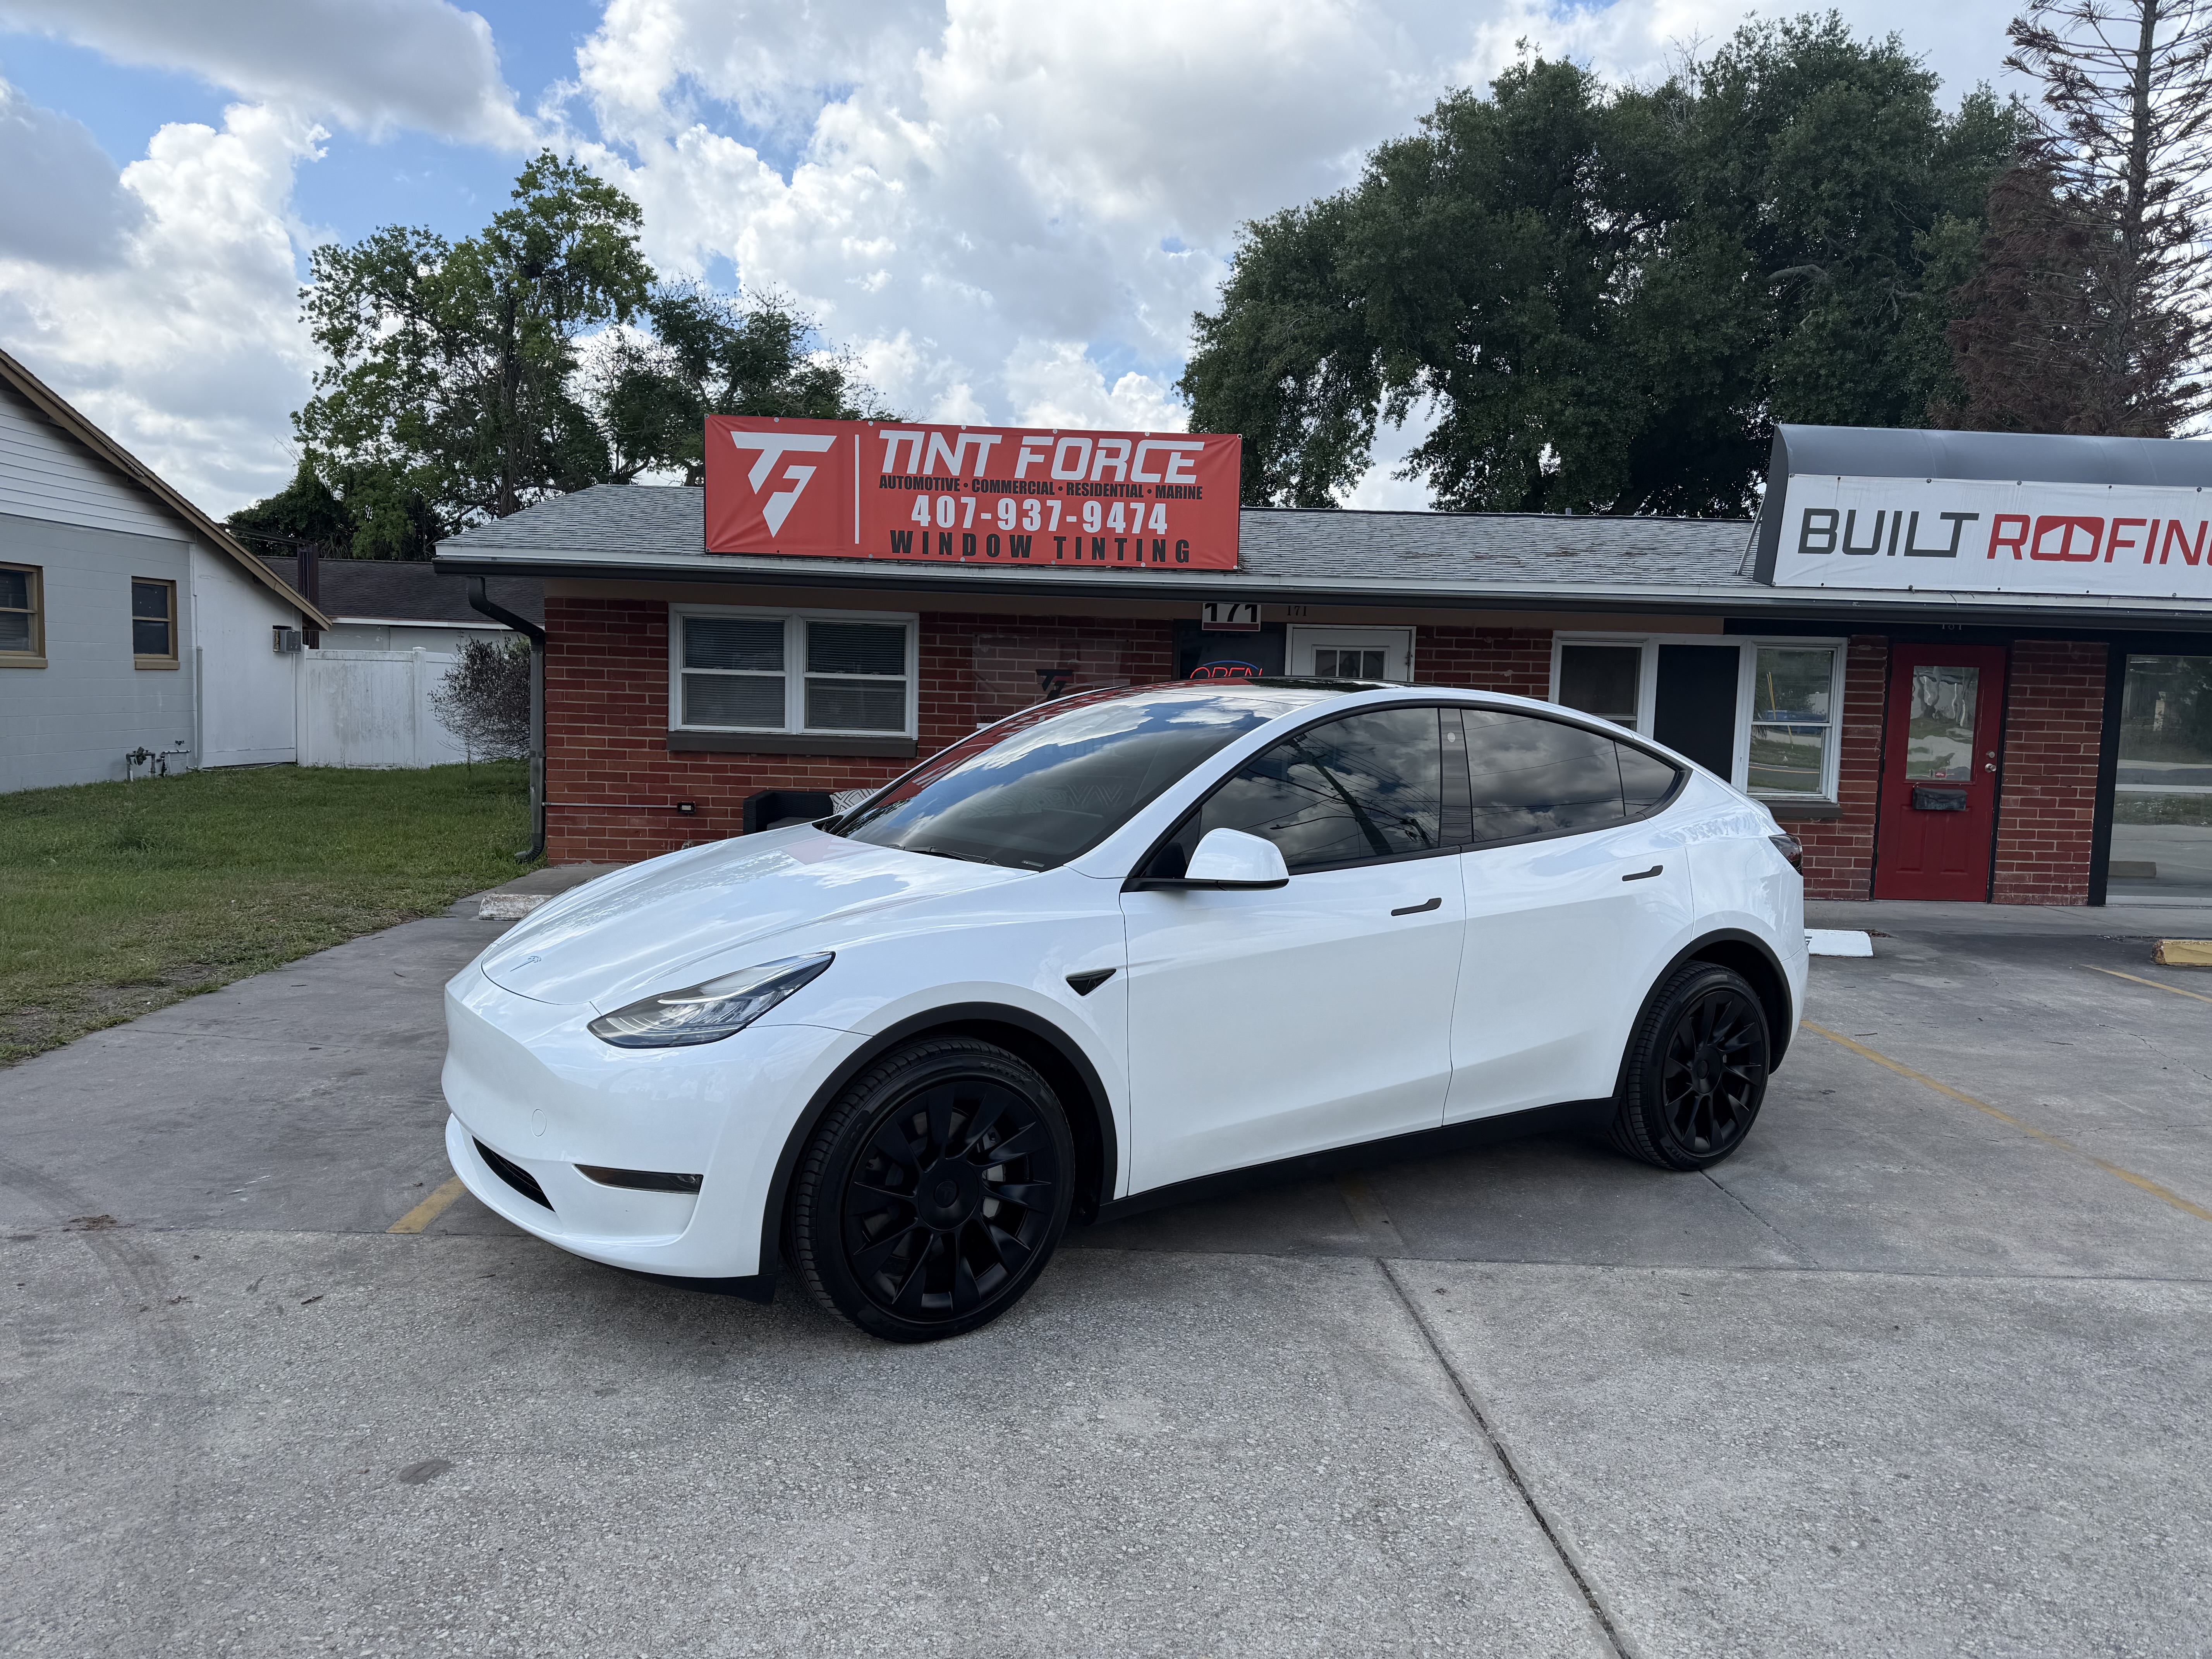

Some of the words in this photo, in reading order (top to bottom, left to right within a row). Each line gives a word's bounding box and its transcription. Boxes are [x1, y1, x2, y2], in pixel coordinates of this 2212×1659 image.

[879, 429, 1003, 477] TINT
[1014, 436, 1205, 484] FORCE
[879, 475, 960, 492] AUTOMOTIVE
[972, 479, 1055, 496] COMMERCIAL
[1066, 482, 1144, 498] RESIDENTIAL
[1155, 485, 1203, 500] MARINE
[911, 495, 1167, 534] 407-937-9474
[890, 530, 1032, 558] WINDOW
[1053, 536, 1189, 563] TINTING
[1798, 508, 1980, 558] BUILT
[1987, 514, 2212, 566] ROOFIN
[1205, 603, 1257, 623] 171
[1287, 606, 1307, 616] 171
